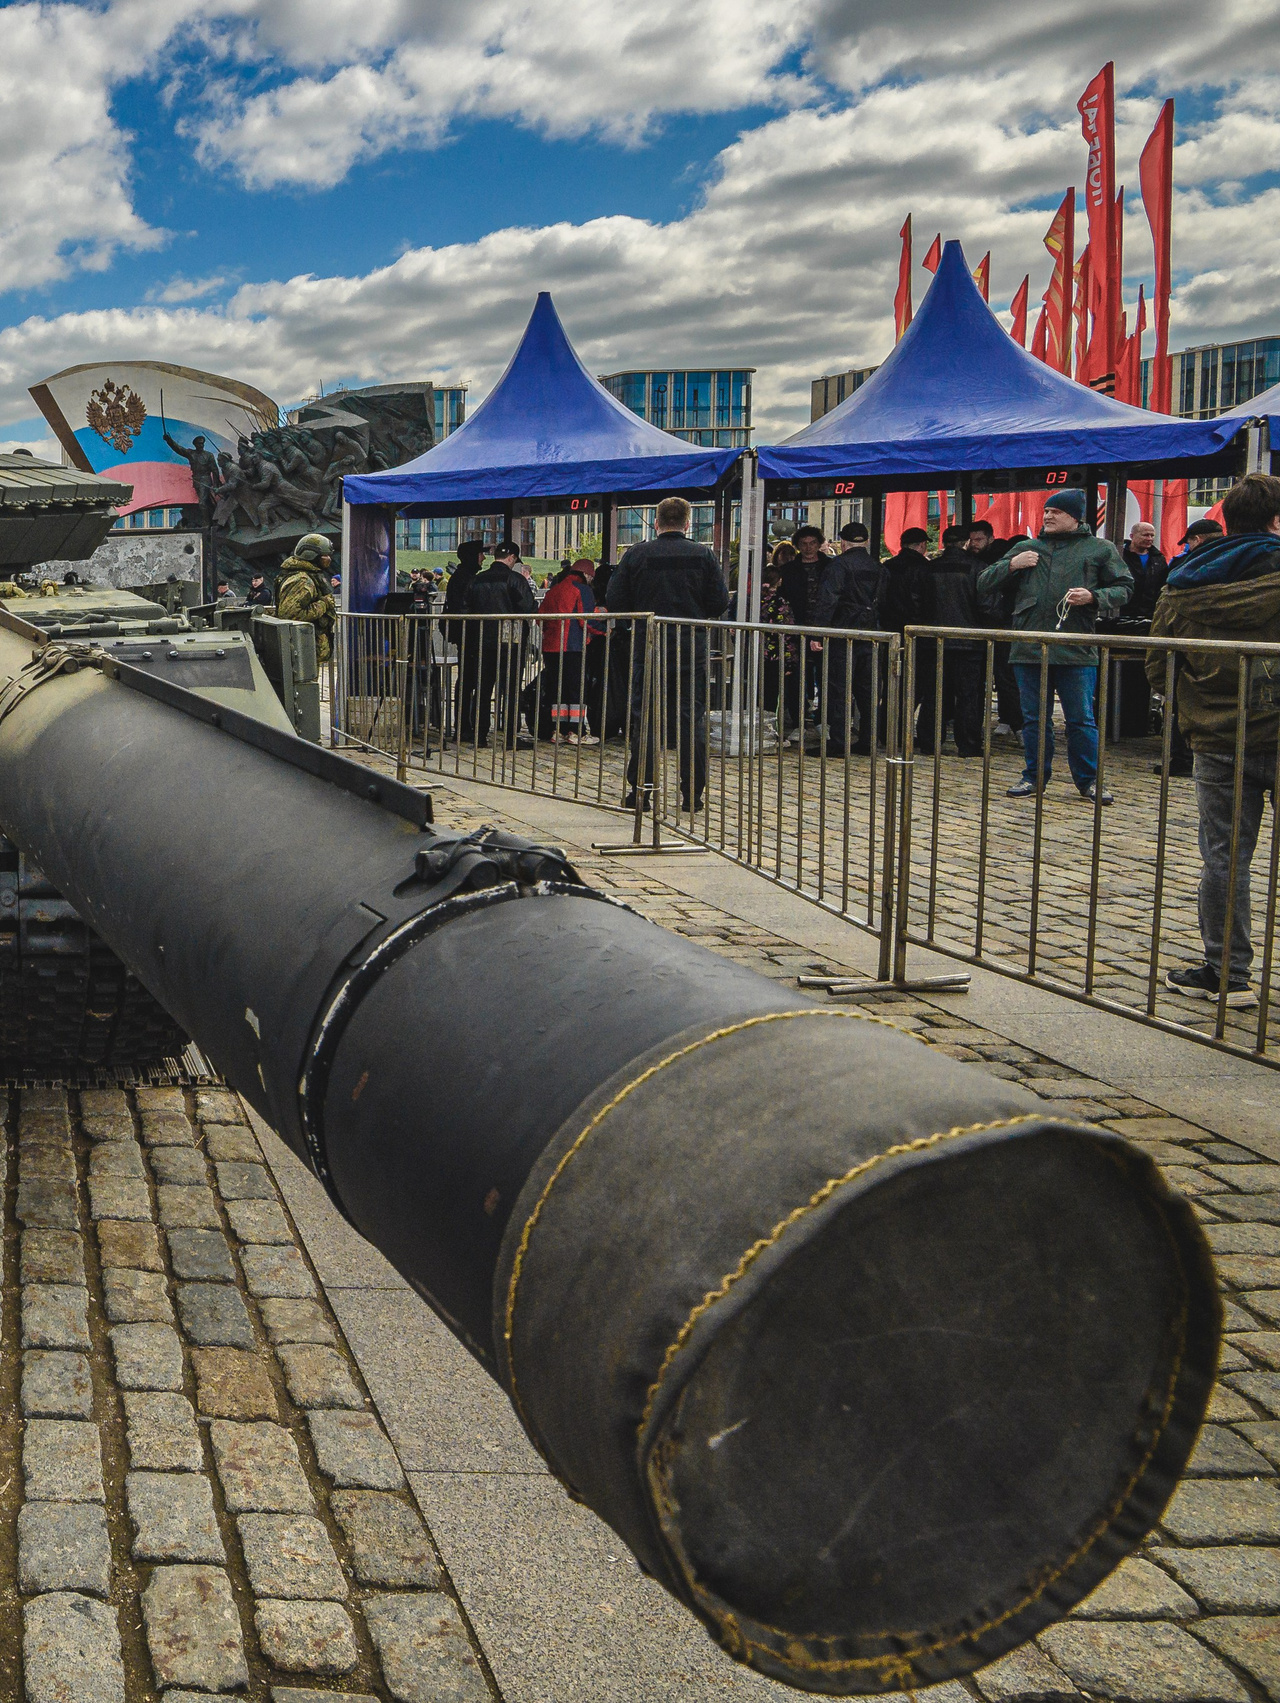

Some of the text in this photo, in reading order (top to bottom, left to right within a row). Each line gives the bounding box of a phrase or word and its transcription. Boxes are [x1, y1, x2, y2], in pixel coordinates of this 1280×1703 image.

[1046, 471, 1068, 484] 03
[835, 482, 855, 494] 02
[570, 499, 588, 510] 01
